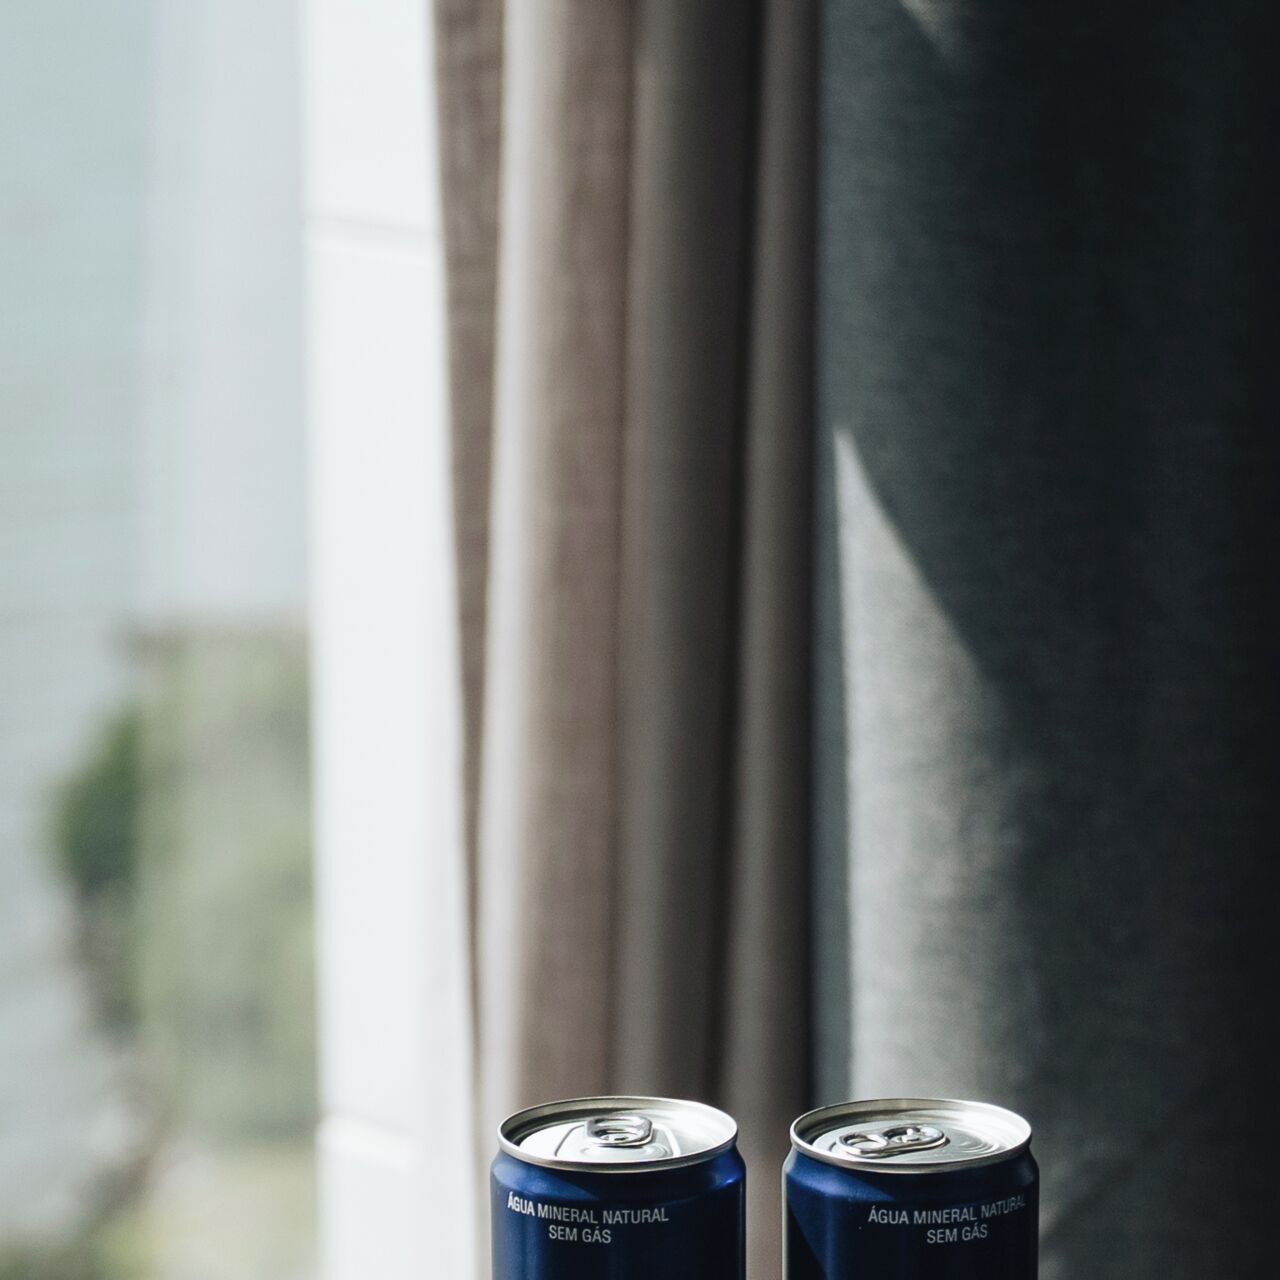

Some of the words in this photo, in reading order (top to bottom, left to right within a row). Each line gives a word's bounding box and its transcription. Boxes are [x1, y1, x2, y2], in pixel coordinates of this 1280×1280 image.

[507, 1191, 535, 1217] ÁGUA
[537, 1203, 598, 1224] MINERAL
[602, 1208, 669, 1224] NATURAL
[868, 1205, 909, 1224] ÁGUA
[913, 1208, 977, 1224] MINERAL
[981, 1194, 1026, 1219] NATURAL
[549, 1225, 578, 1241] SEM
[582, 1226, 612, 1243] GÁS
[926, 1228, 958, 1244] SEM
[961, 1222, 988, 1241] GÁS
